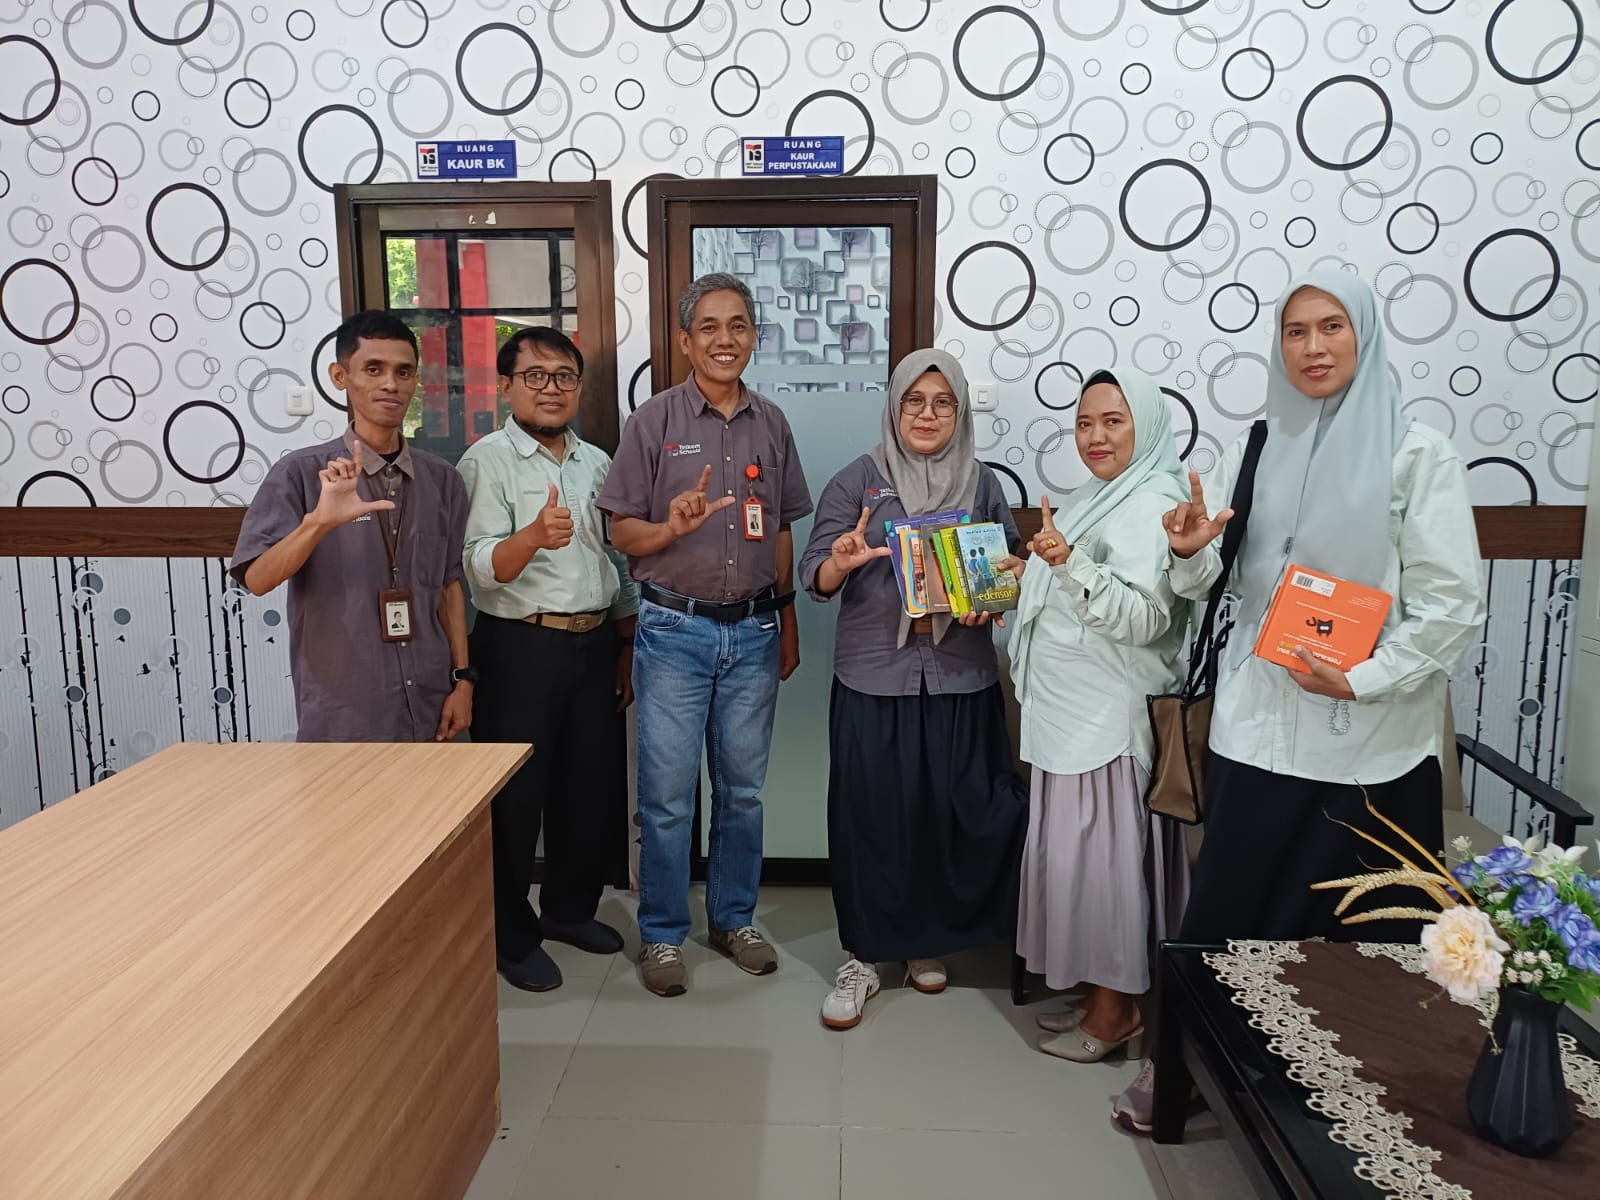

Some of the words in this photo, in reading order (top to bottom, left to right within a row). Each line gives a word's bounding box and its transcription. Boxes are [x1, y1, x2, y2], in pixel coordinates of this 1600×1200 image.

[784, 141, 821, 149] RUANG
[790, 152, 815, 160] KAUR
[447, 159, 483, 169] KAUR
[486, 158, 505, 169] BK
[768, 161, 837, 170] PERPUSTAKAAN
[978, 588, 1013, 601] edensor
